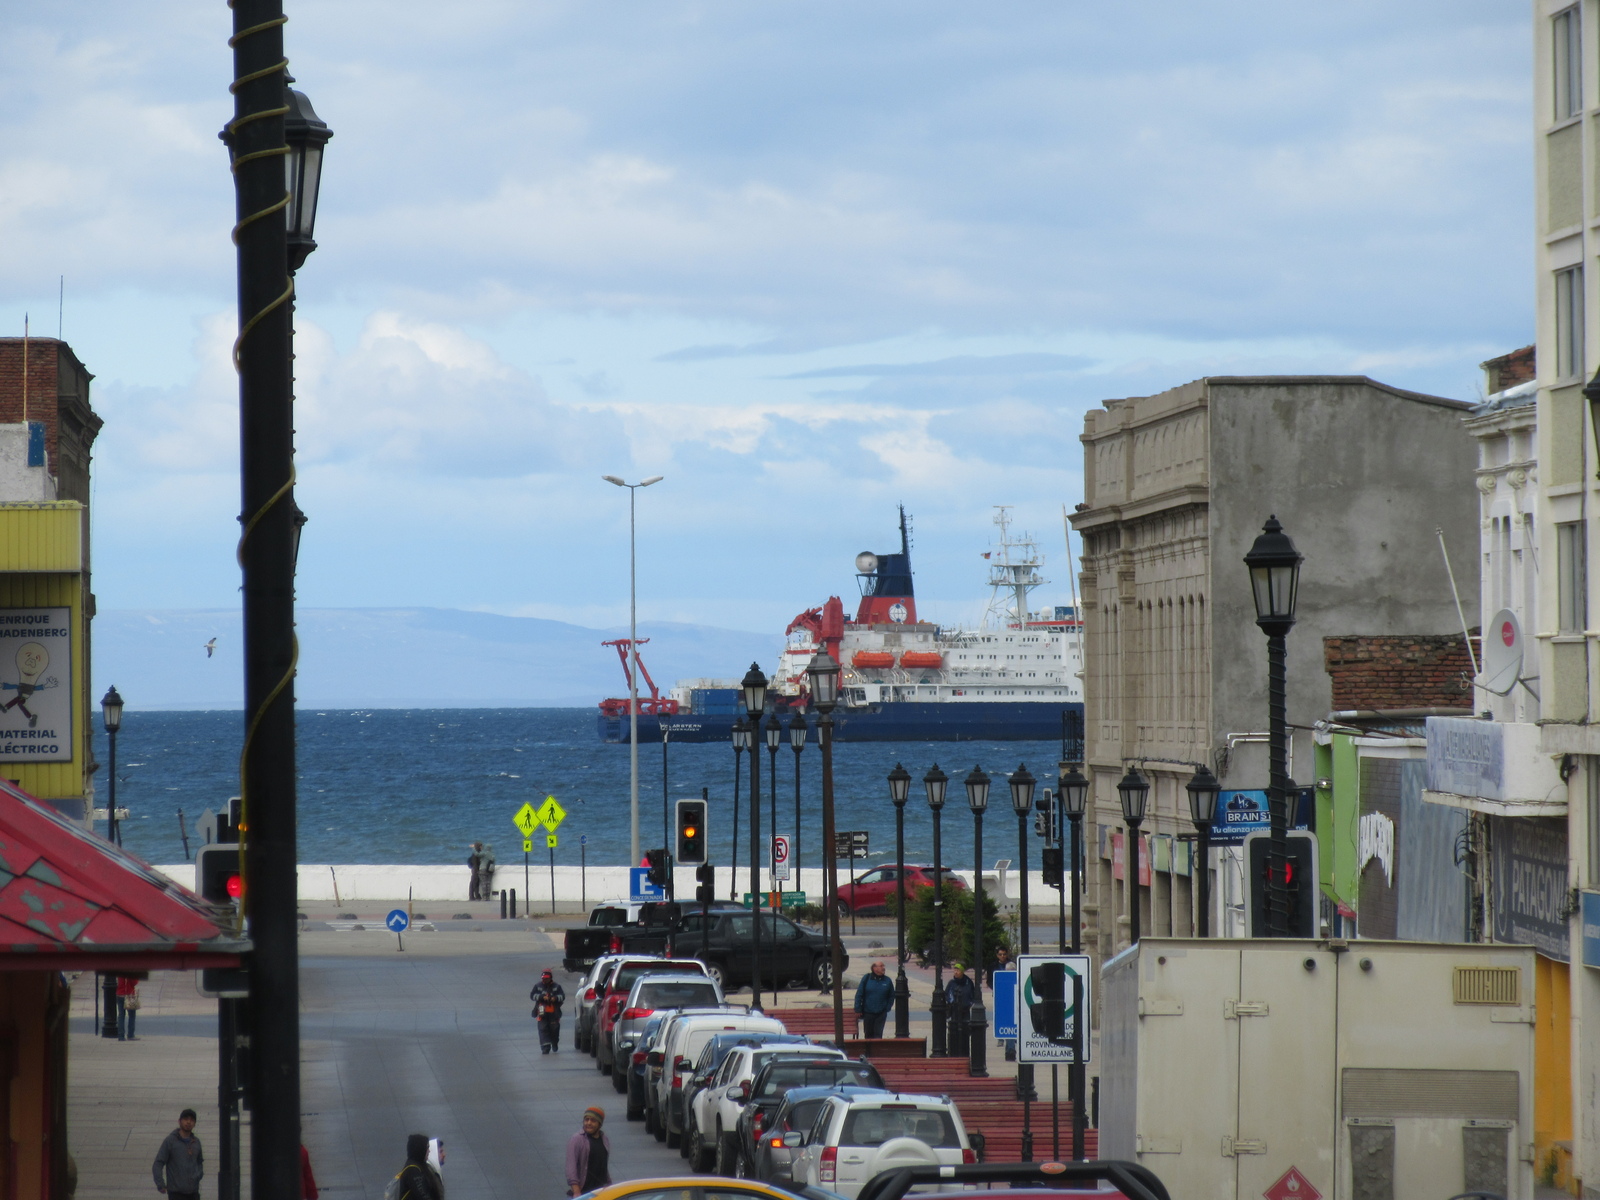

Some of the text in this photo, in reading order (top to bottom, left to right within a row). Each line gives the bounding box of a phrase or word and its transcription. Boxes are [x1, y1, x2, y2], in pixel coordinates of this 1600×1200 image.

[1228, 813, 1259, 821] BRAIN
[1212, 826, 1221, 834] Tu
[1222, 825, 1250, 833] alianza
[640, 874, 655, 895] E
[1031, 1050, 1074, 1058] MAGALLANE
